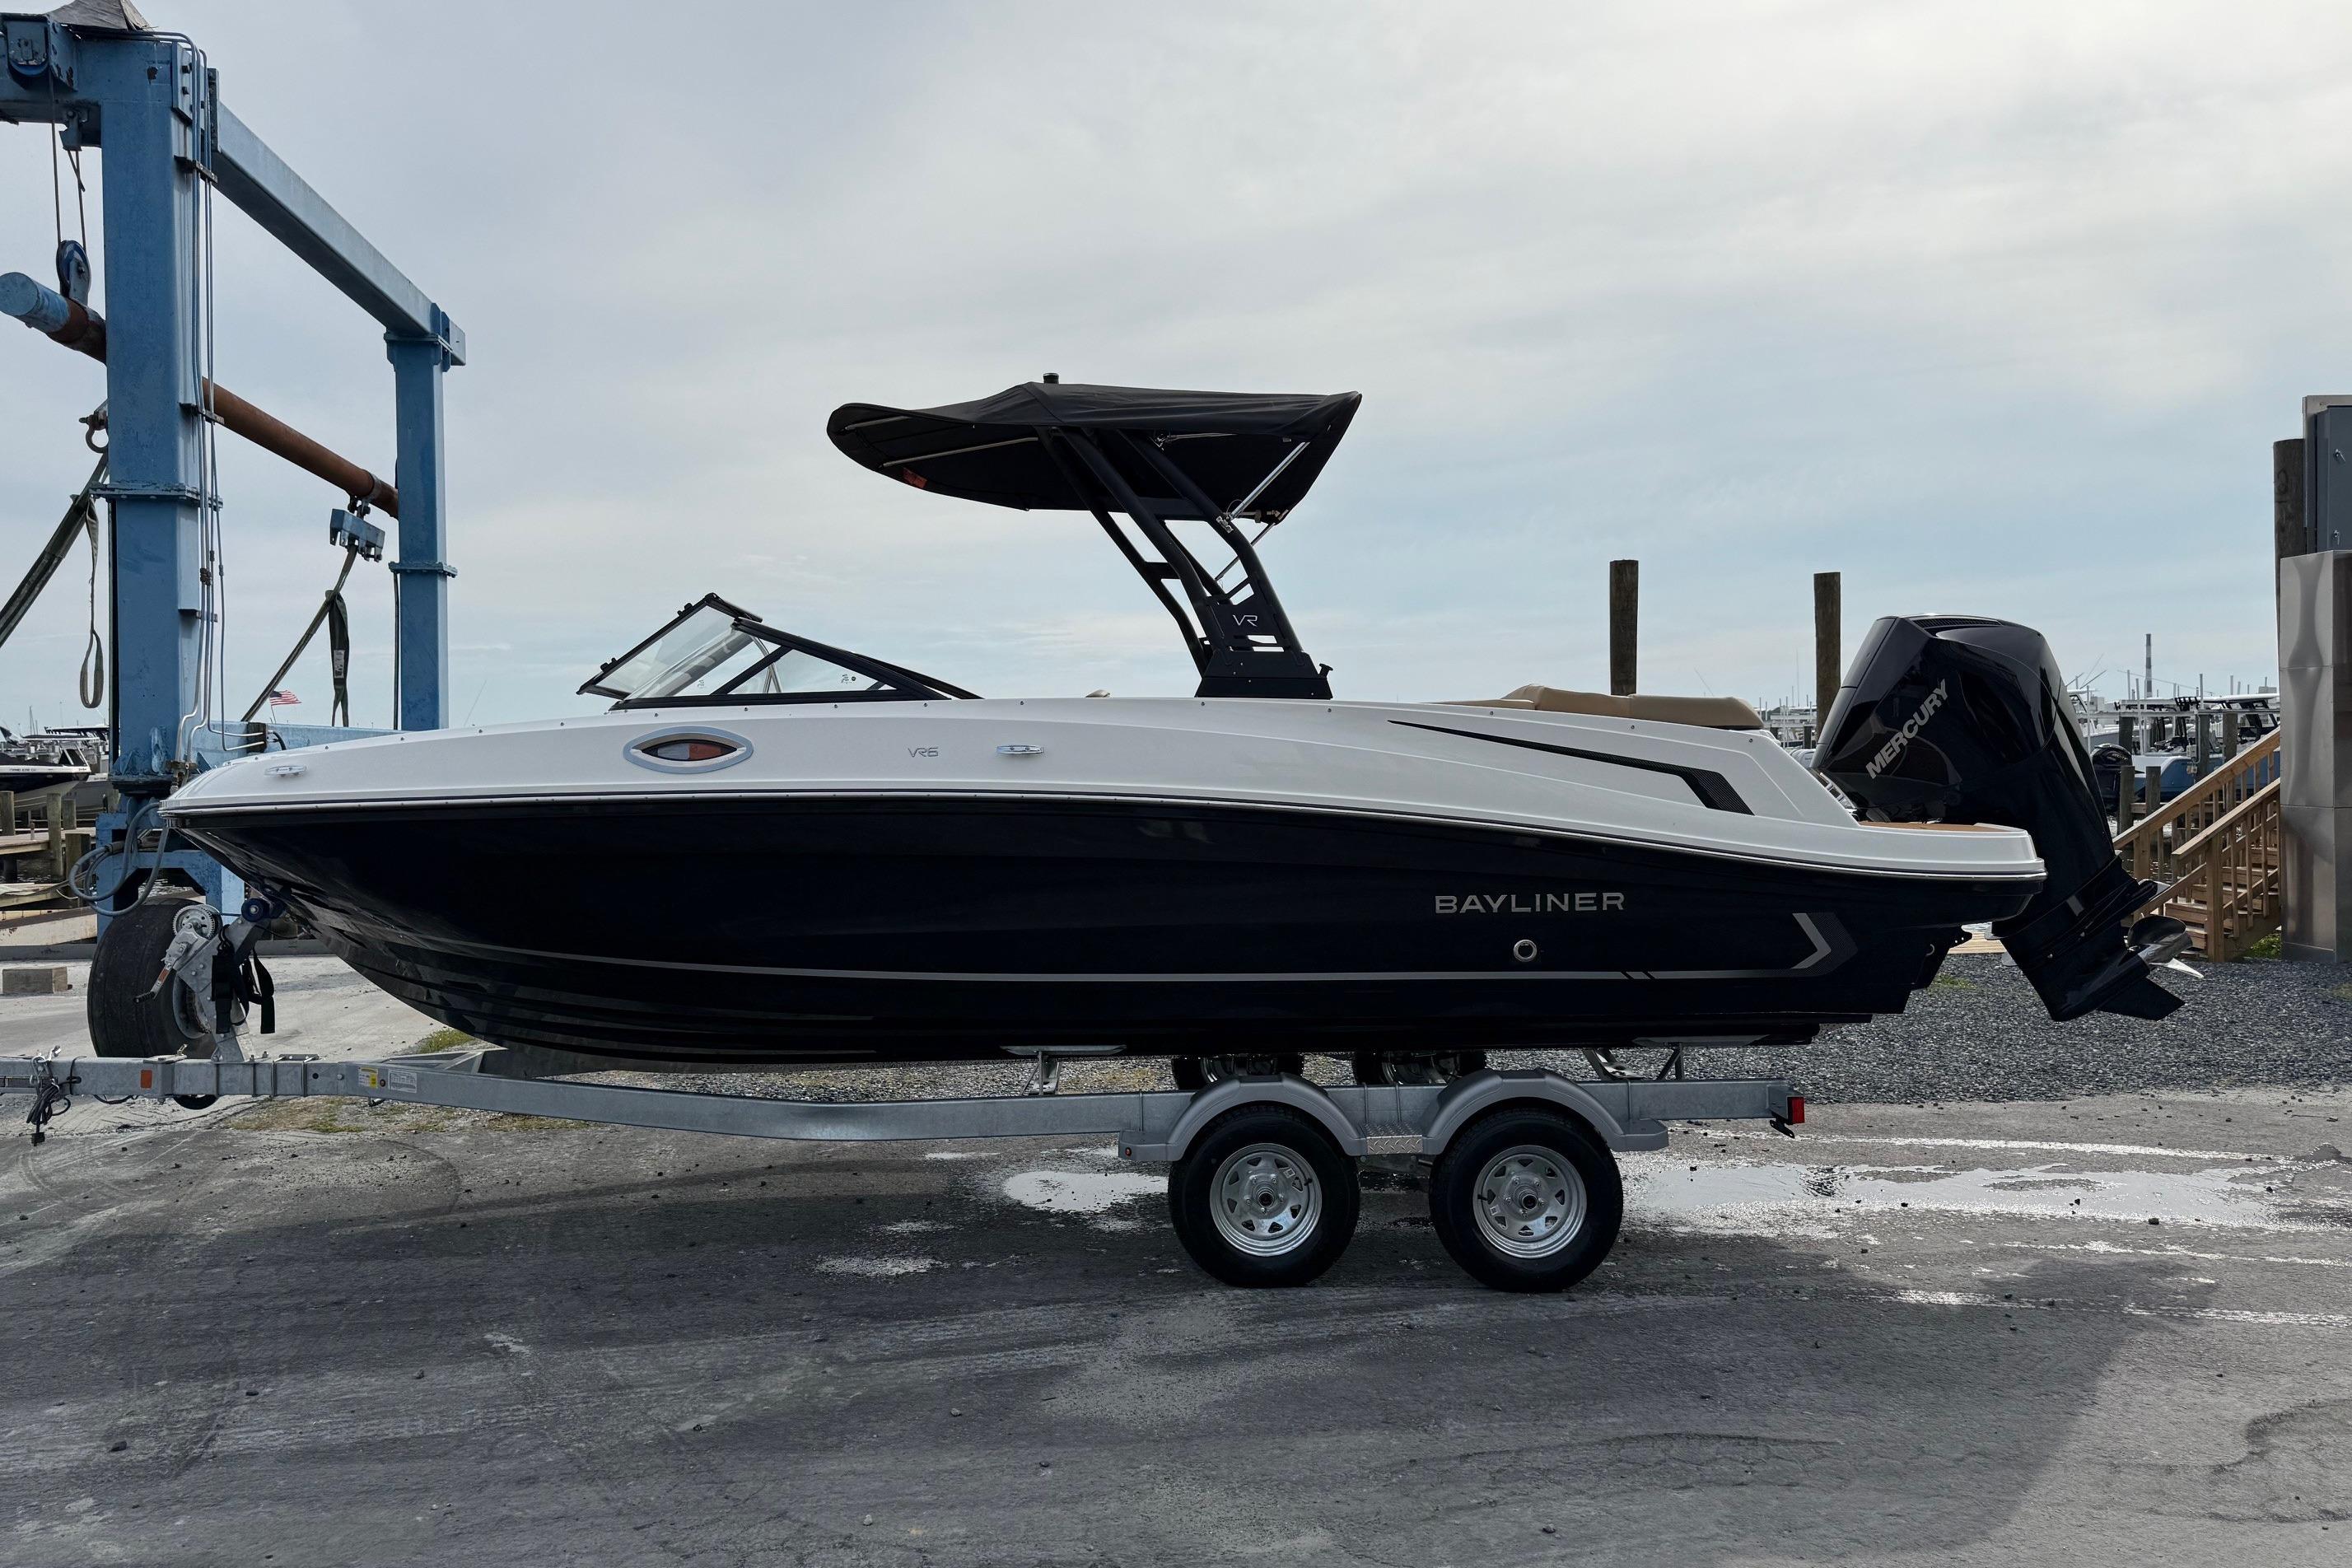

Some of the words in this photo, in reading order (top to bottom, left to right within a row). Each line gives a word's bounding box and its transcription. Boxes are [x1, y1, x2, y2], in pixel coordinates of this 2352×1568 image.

[1233, 614, 1258, 627] VR
[1865, 679, 1948, 779] MERCURY
[1435, 892, 1625, 914] BAYLINER
